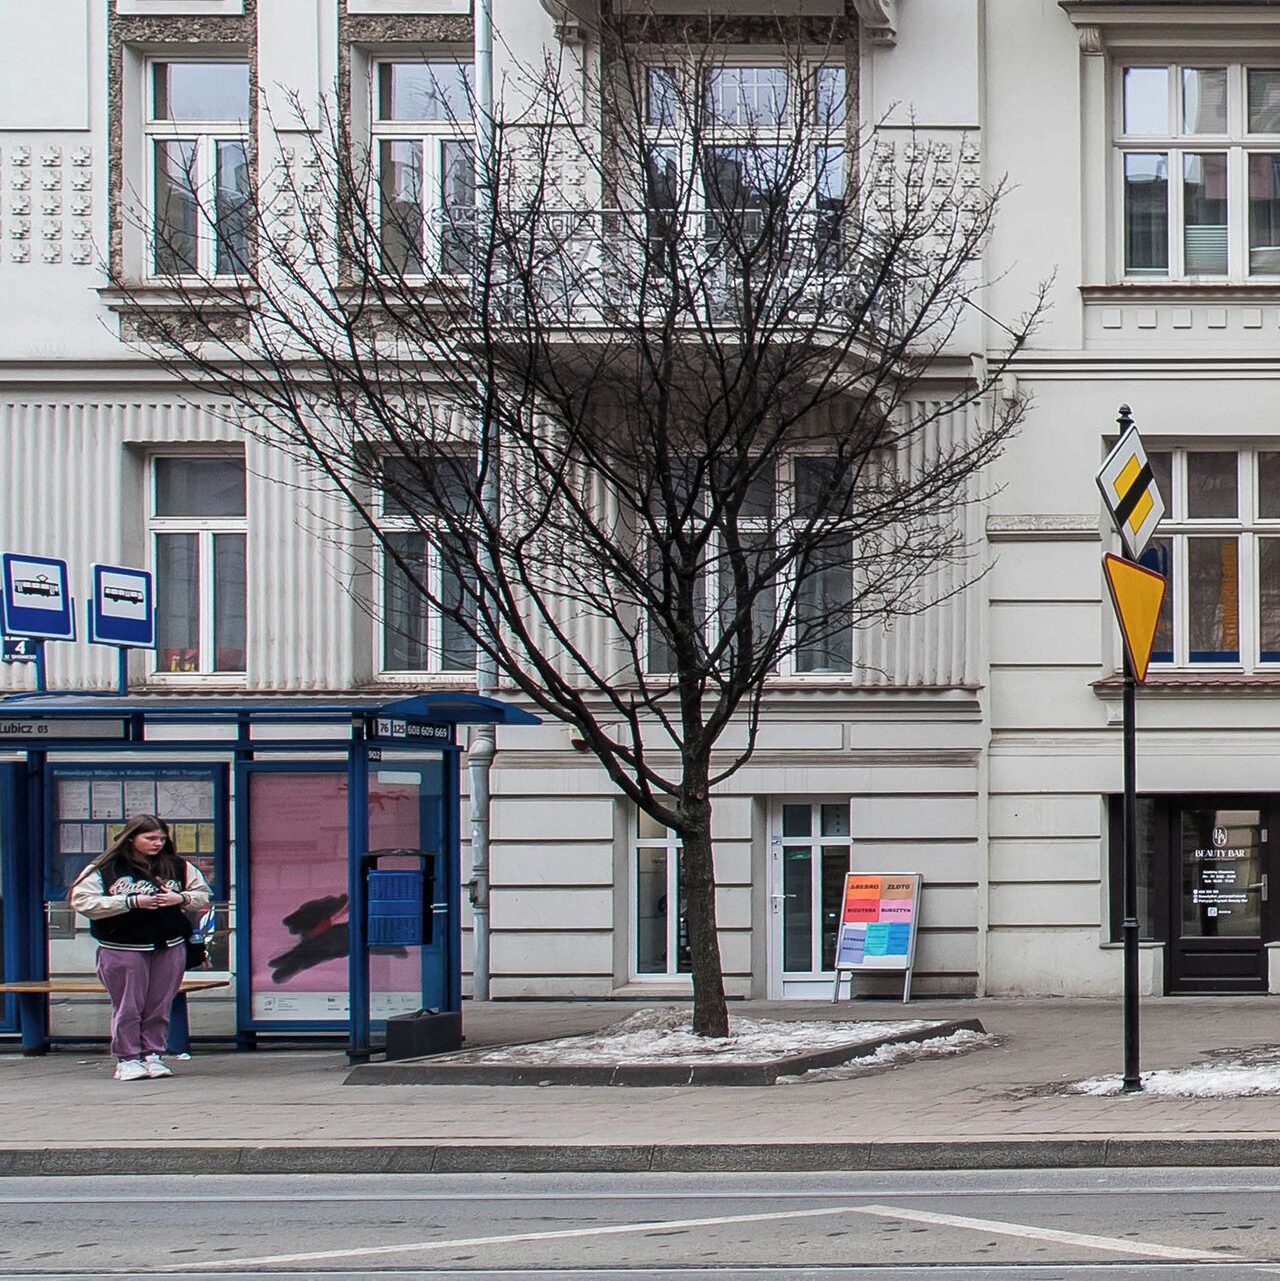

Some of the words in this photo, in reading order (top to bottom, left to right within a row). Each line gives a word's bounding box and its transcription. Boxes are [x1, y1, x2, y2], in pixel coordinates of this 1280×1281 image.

[14, 640, 26, 655] 4
[0, 722, 33, 734] Lubicz
[380, 723, 389, 733] 76
[393, 724, 406, 734] 125
[407, 725, 421, 735] 608
[421, 726, 434, 737] 609
[434, 727, 448, 738] 669
[368, 751, 381, 759] 902
[1195, 849, 1227, 857] BEAUTY
[1228, 849, 1245, 857] BAR
